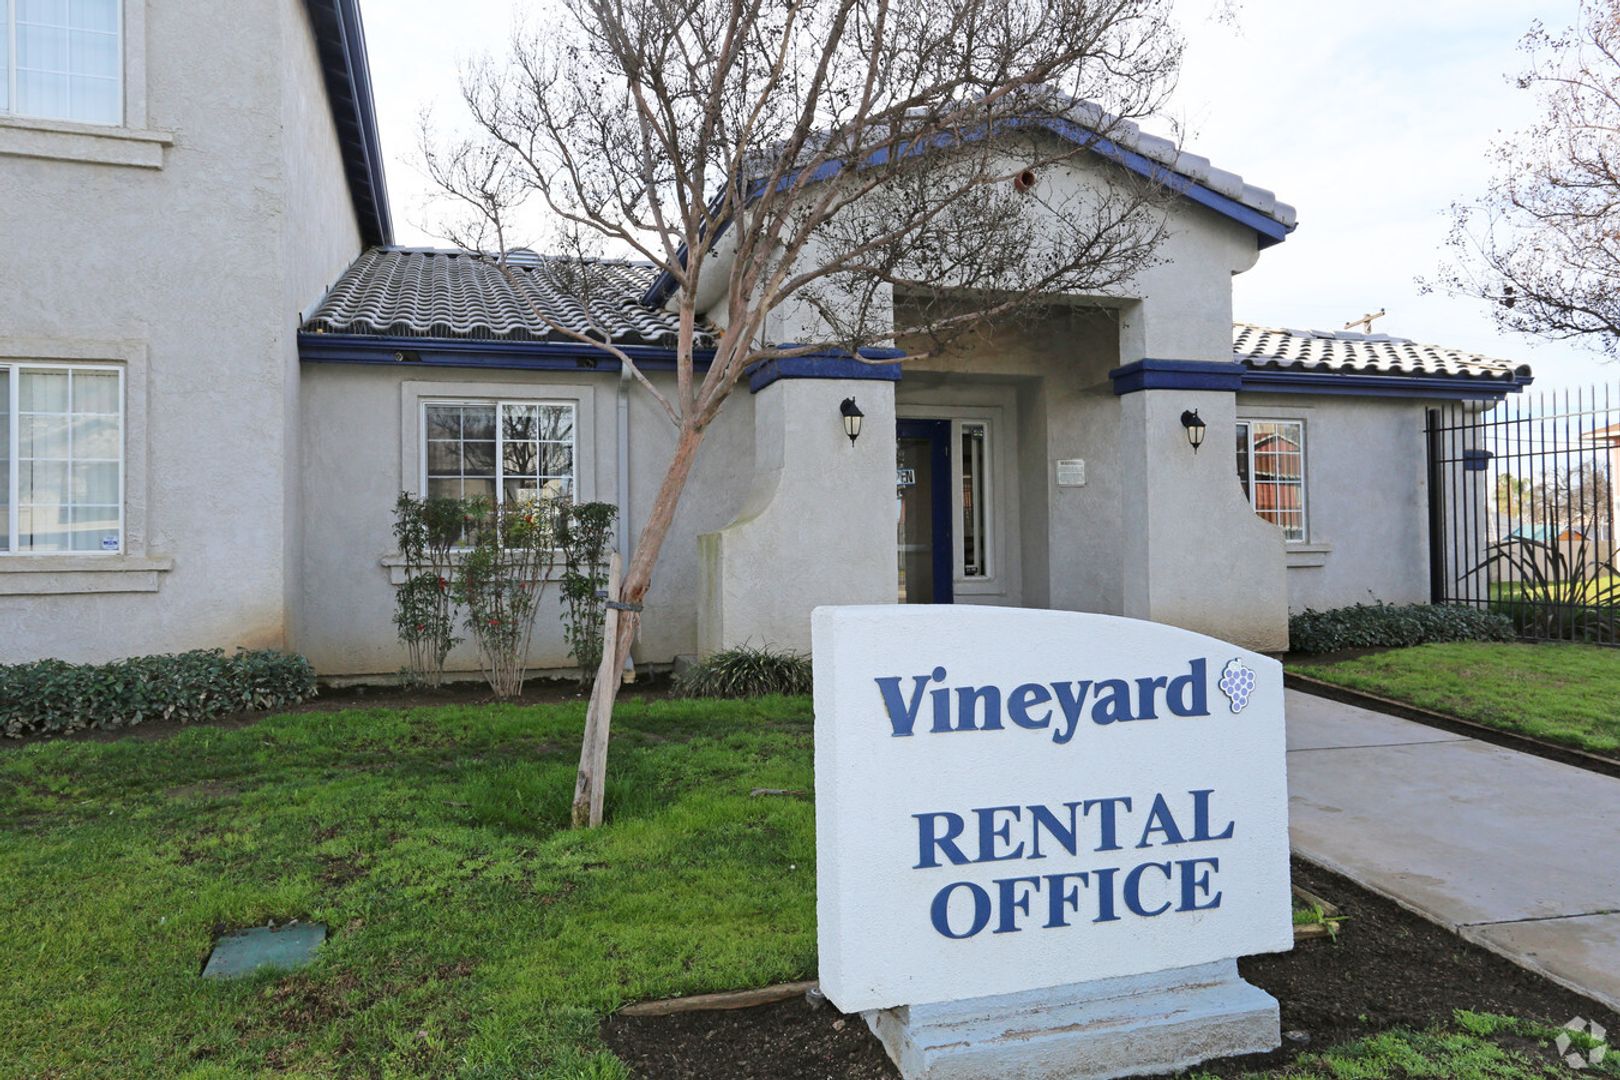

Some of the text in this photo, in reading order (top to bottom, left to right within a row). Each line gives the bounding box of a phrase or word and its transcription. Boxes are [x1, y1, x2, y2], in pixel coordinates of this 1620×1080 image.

[874, 657, 1211, 745] Vineyard
[911, 789, 1235, 869] RENTAL
[930, 857, 1222, 939] OFFICE
